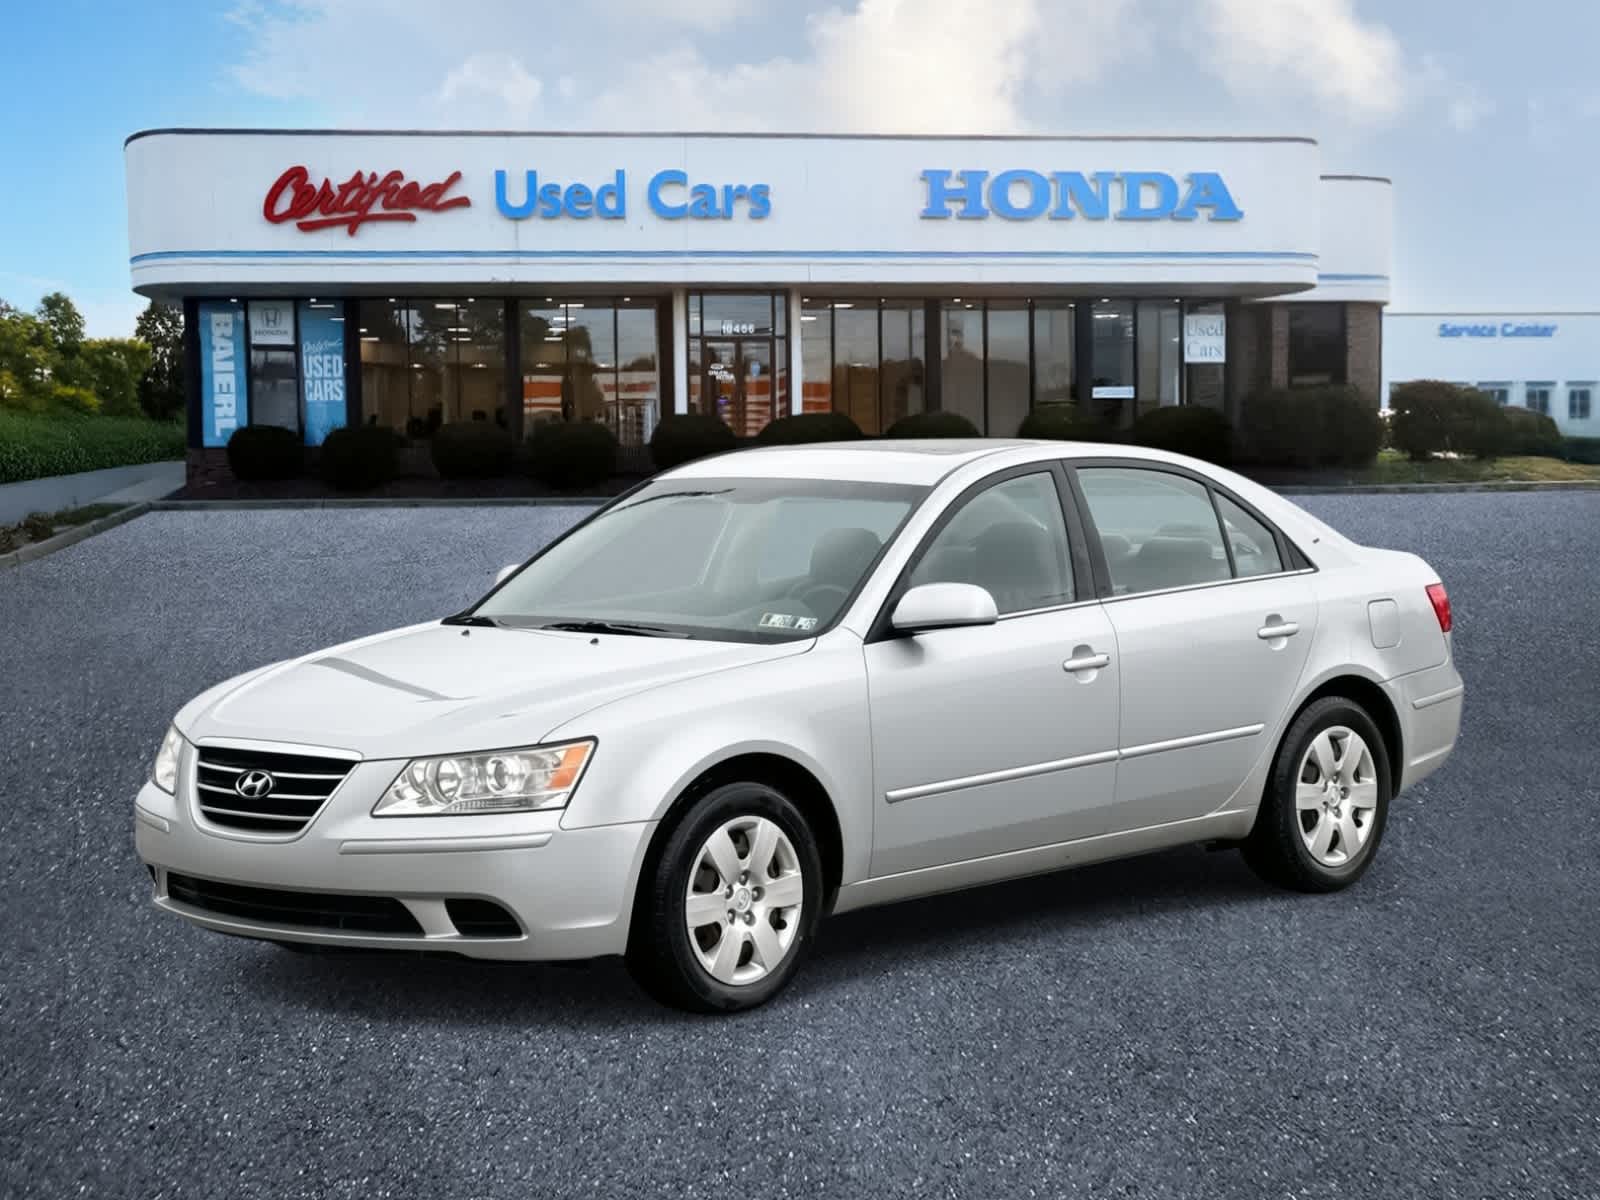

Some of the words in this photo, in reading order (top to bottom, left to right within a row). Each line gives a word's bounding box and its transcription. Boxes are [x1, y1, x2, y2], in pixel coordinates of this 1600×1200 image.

[263, 165, 471, 236] Certified
[494, 168, 626, 221] Used
[647, 168, 771, 221] Cars
[919, 168, 1244, 222] HONDA
[1187, 318, 1224, 337] Used
[1438, 323, 1497, 337] Service
[1501, 323, 1557, 337] Center
[1187, 341, 1223, 357] Cars
[211, 313, 236, 437] BAIERL
[302, 354, 343, 378] USED
[304, 379, 344, 401] CARS
